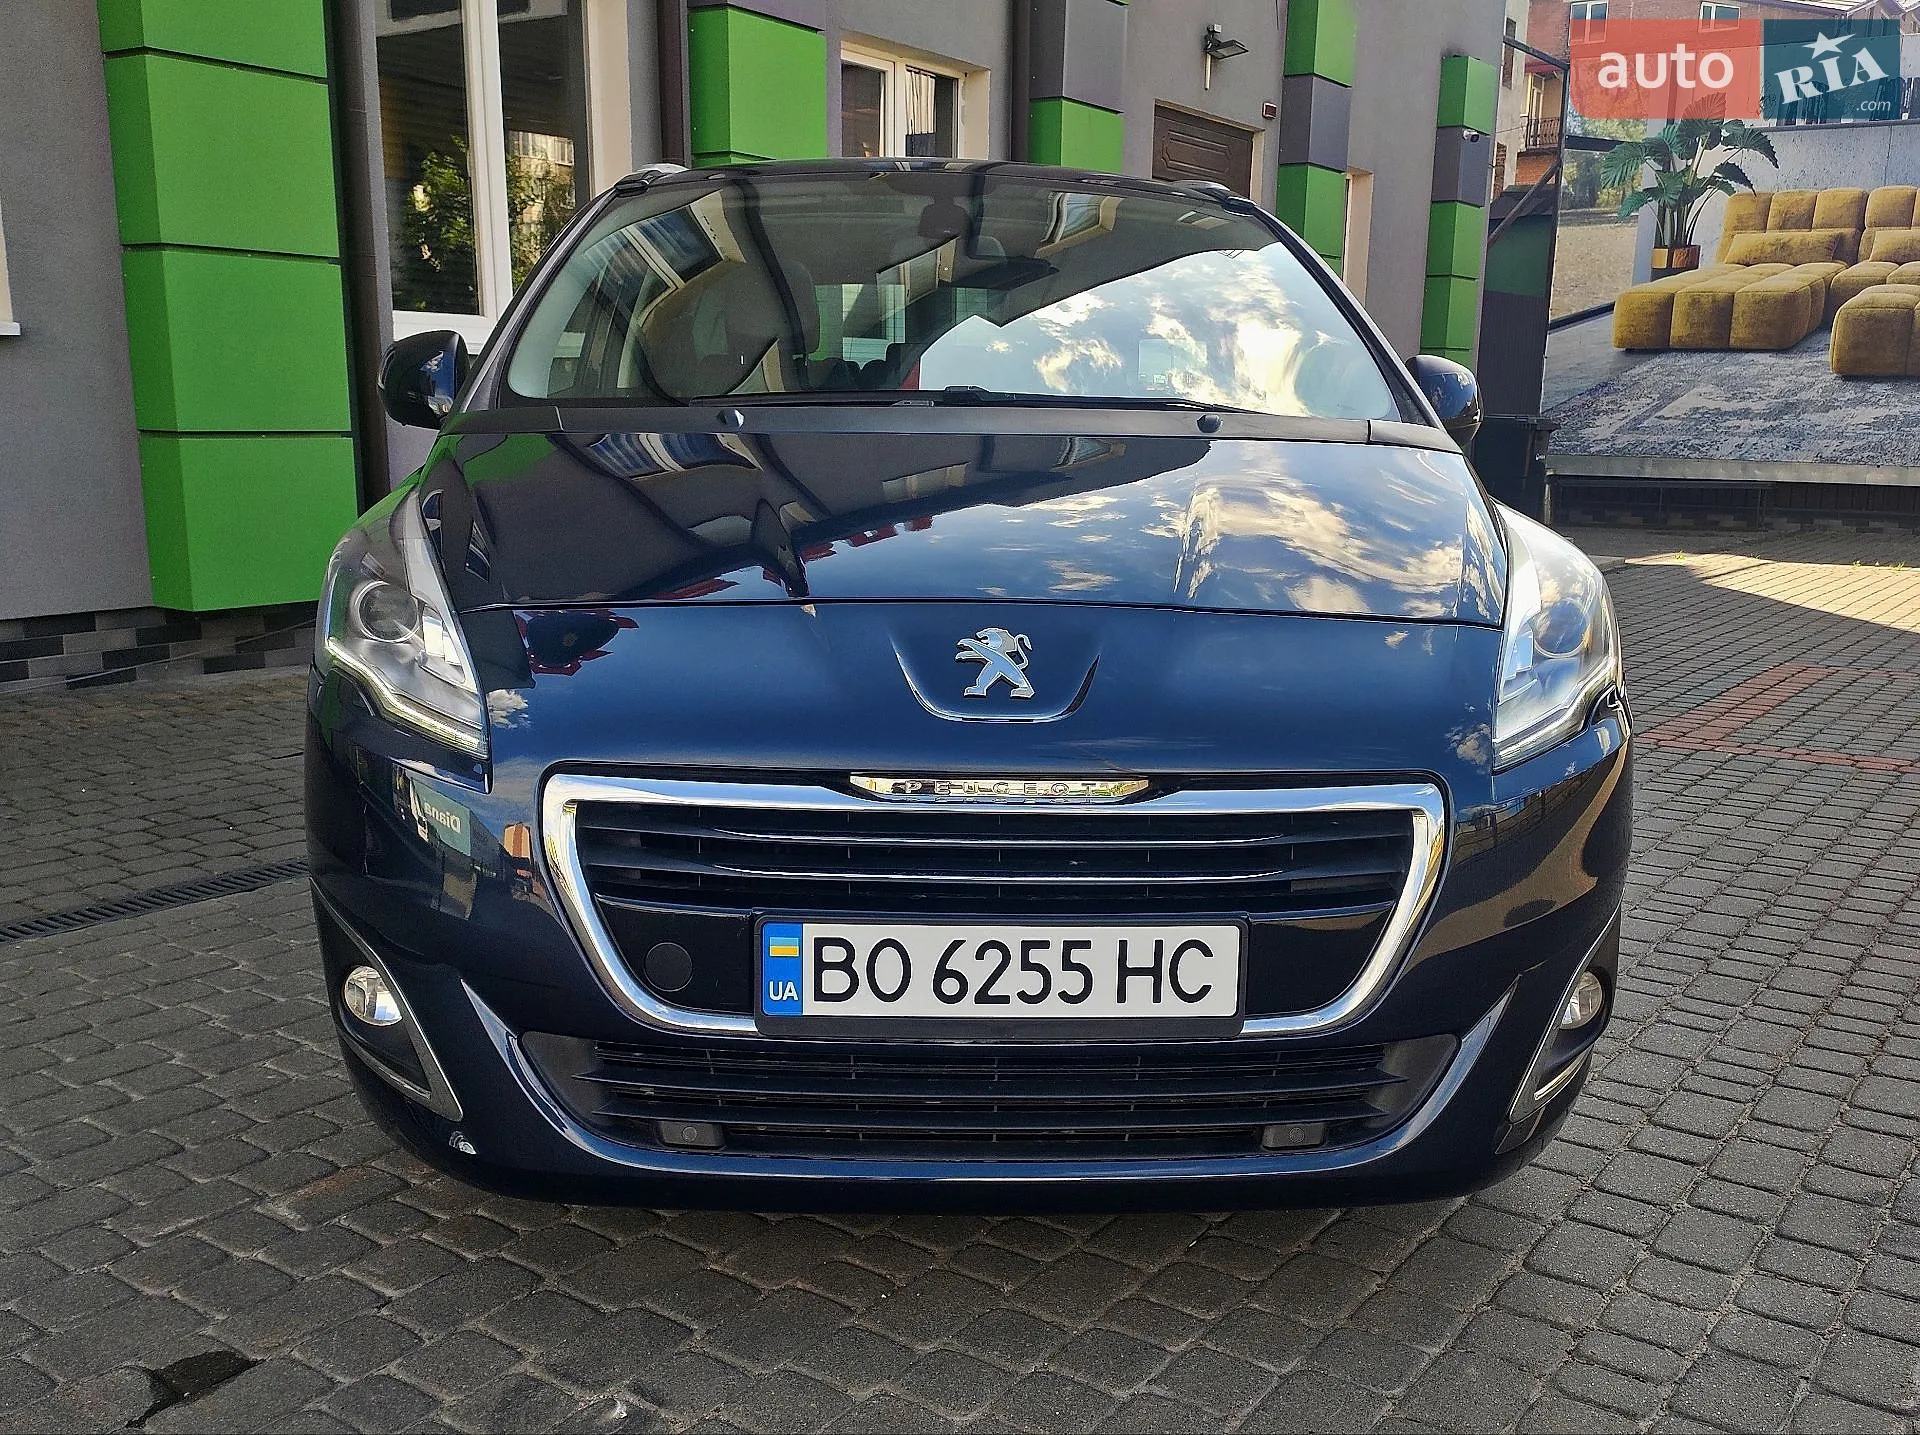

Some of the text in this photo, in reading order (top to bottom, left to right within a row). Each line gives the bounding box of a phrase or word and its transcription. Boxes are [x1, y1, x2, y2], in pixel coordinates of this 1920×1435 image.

[904, 779, 1097, 797] PEUGEOT
[812, 936, 1214, 1005] BO 6255 HC
[769, 981, 799, 1001] UA
